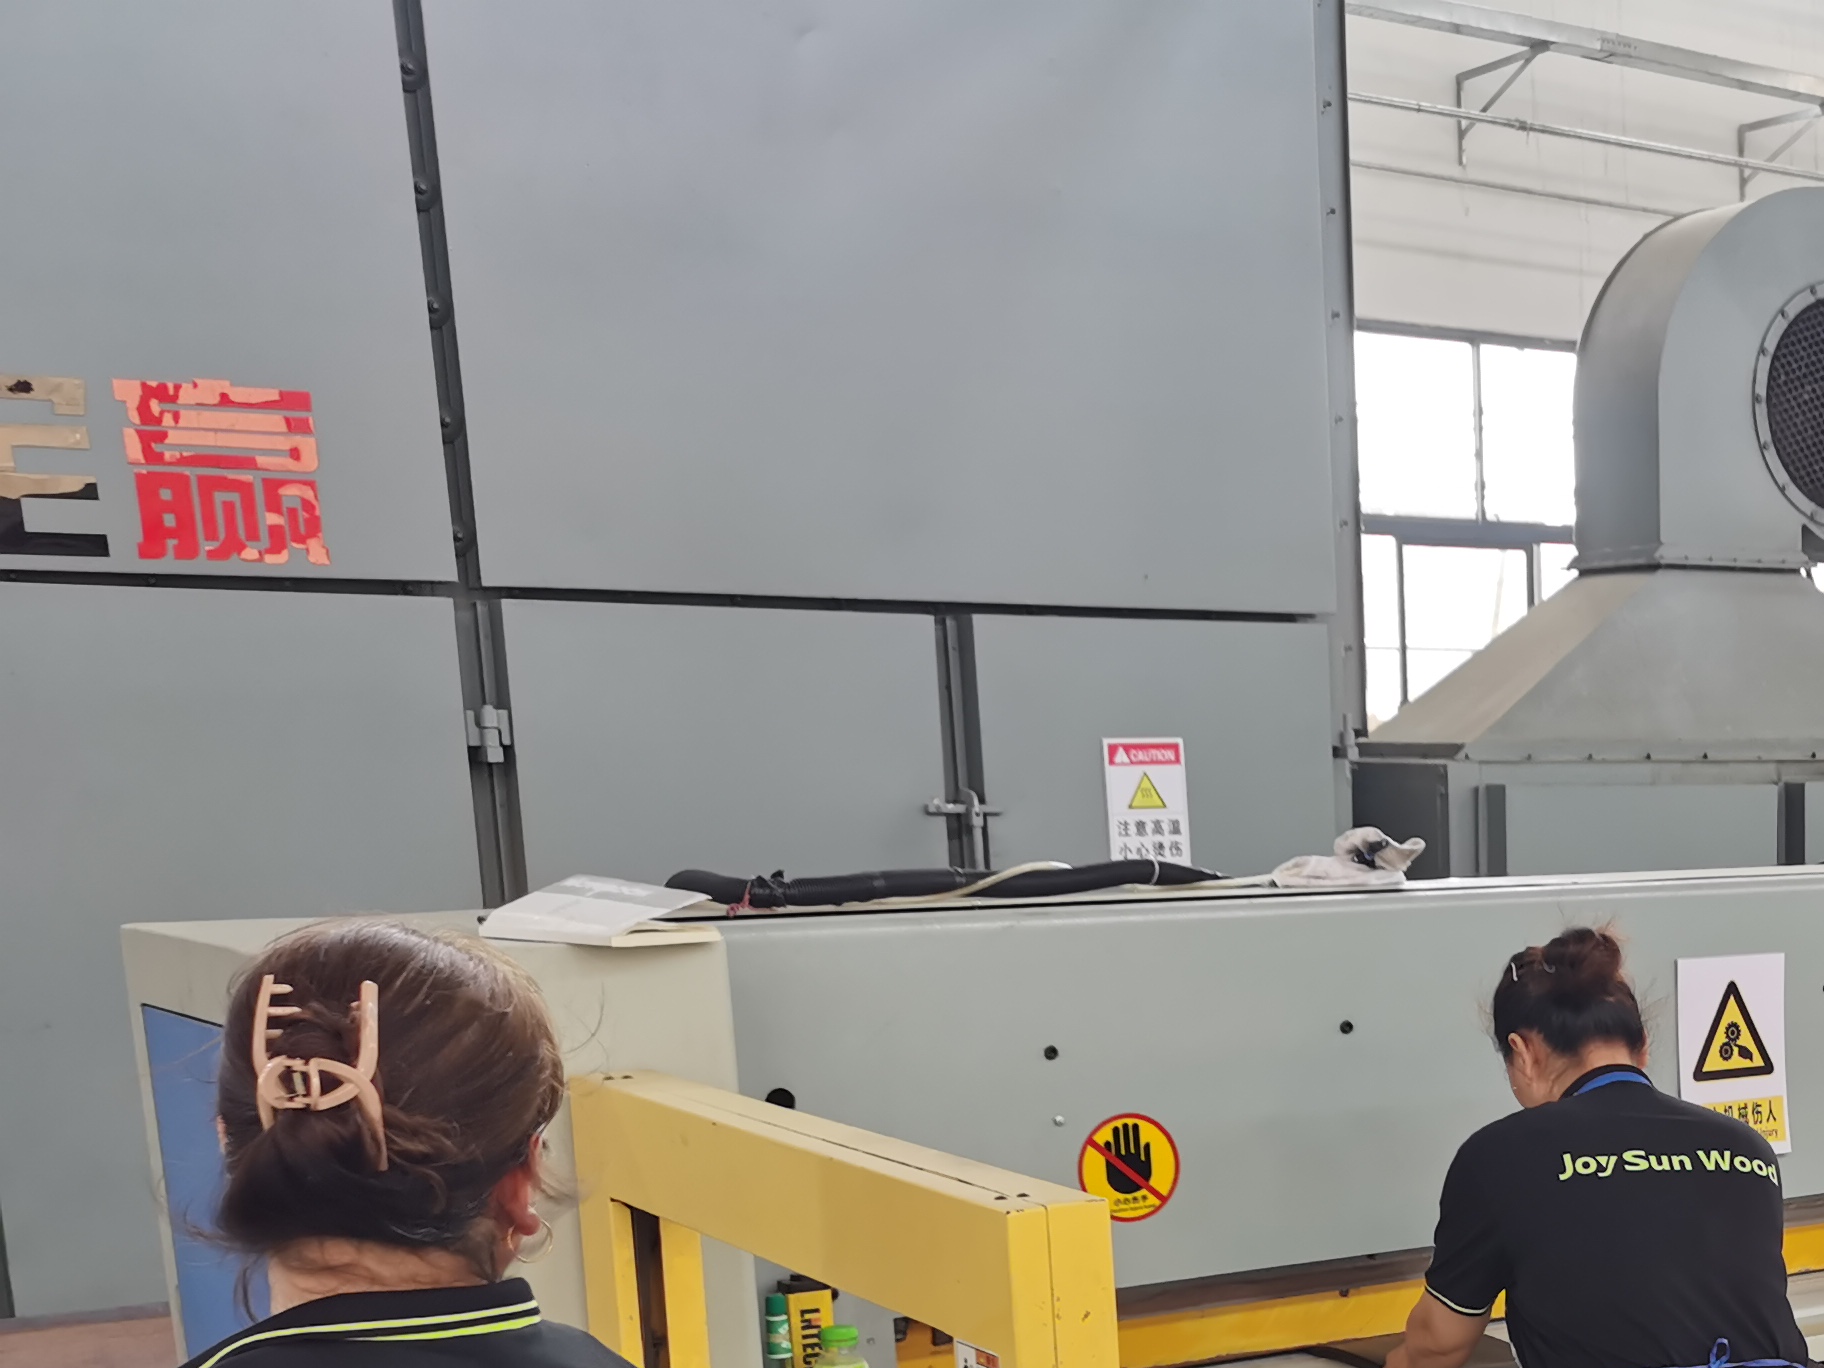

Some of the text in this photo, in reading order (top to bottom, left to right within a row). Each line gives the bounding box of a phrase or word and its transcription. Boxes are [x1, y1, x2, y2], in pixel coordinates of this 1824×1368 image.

[1129, 747, 1176, 762] CAUTION
[1117, 819, 1183, 837] 注意高温
[1558, 1149, 1780, 1187] Joy Sun Wood
